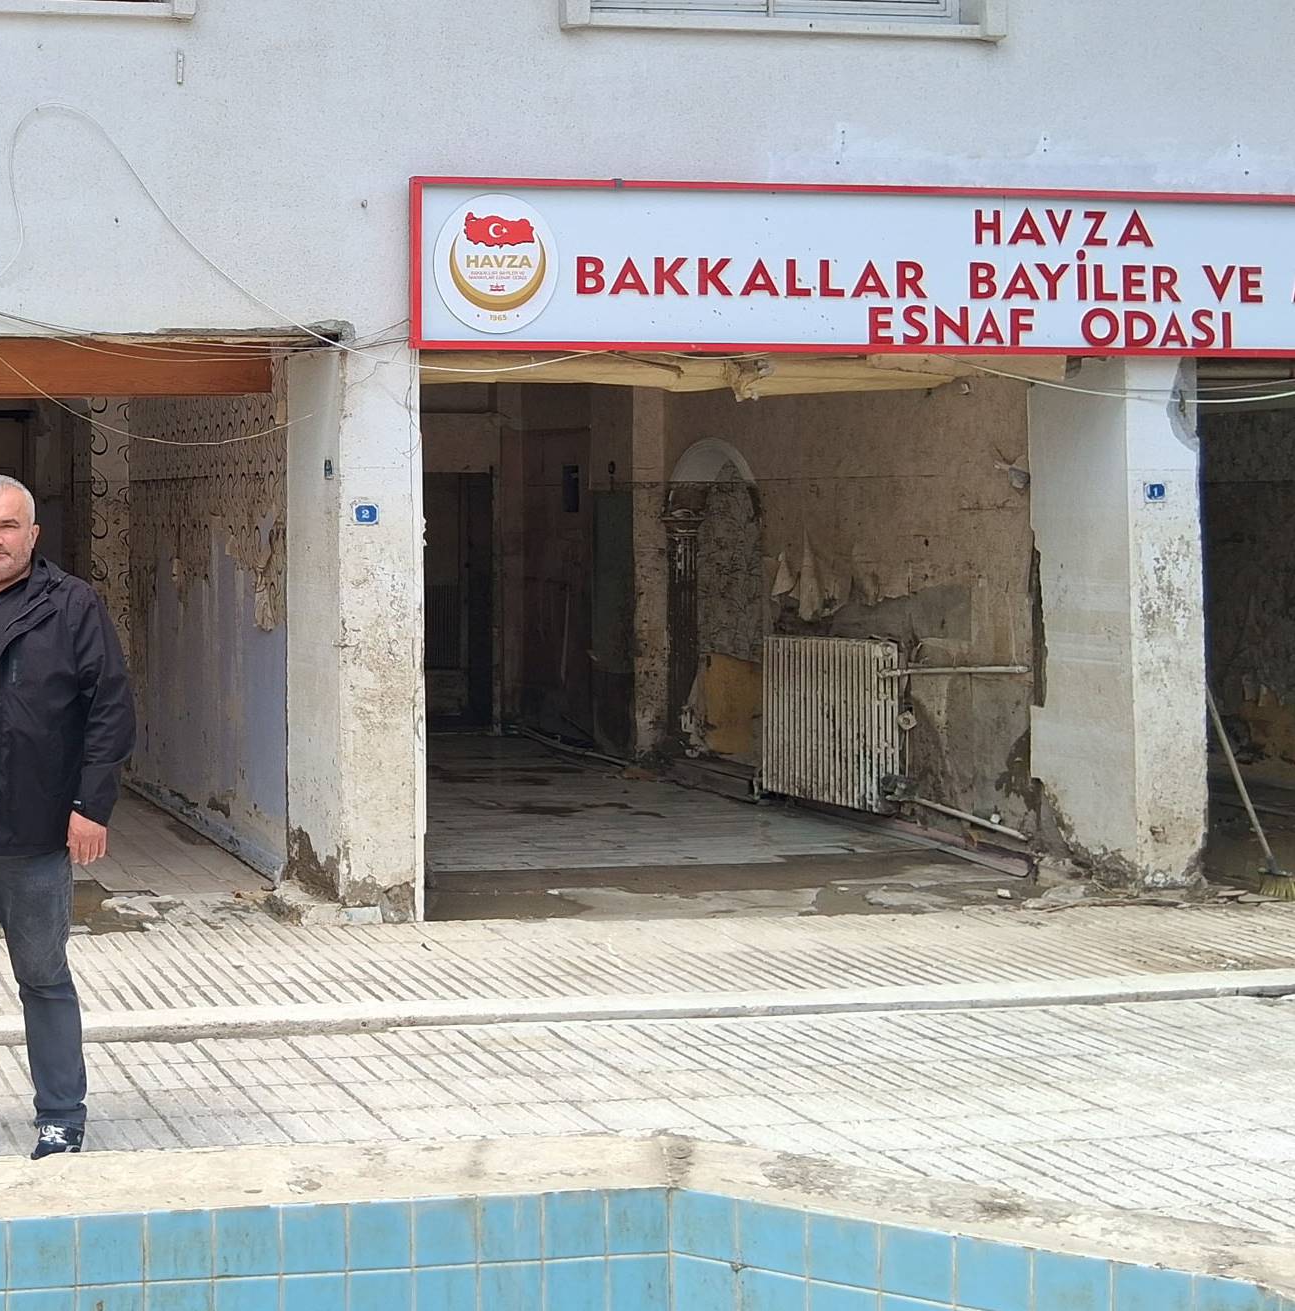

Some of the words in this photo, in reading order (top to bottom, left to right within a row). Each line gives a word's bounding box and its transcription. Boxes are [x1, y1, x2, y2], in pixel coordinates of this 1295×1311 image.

[973, 207, 1155, 247] HAVZA
[466, 254, 532, 269] HAVZA
[576, 255, 929, 299] BAKKALLAR
[969, 249, 1182, 303] BAYİLER
[1201, 265, 1264, 303] VE
[867, 304, 1035, 346] ESNAF
[1080, 307, 1232, 349] ODASI
[361, 508, 370, 519] 2
